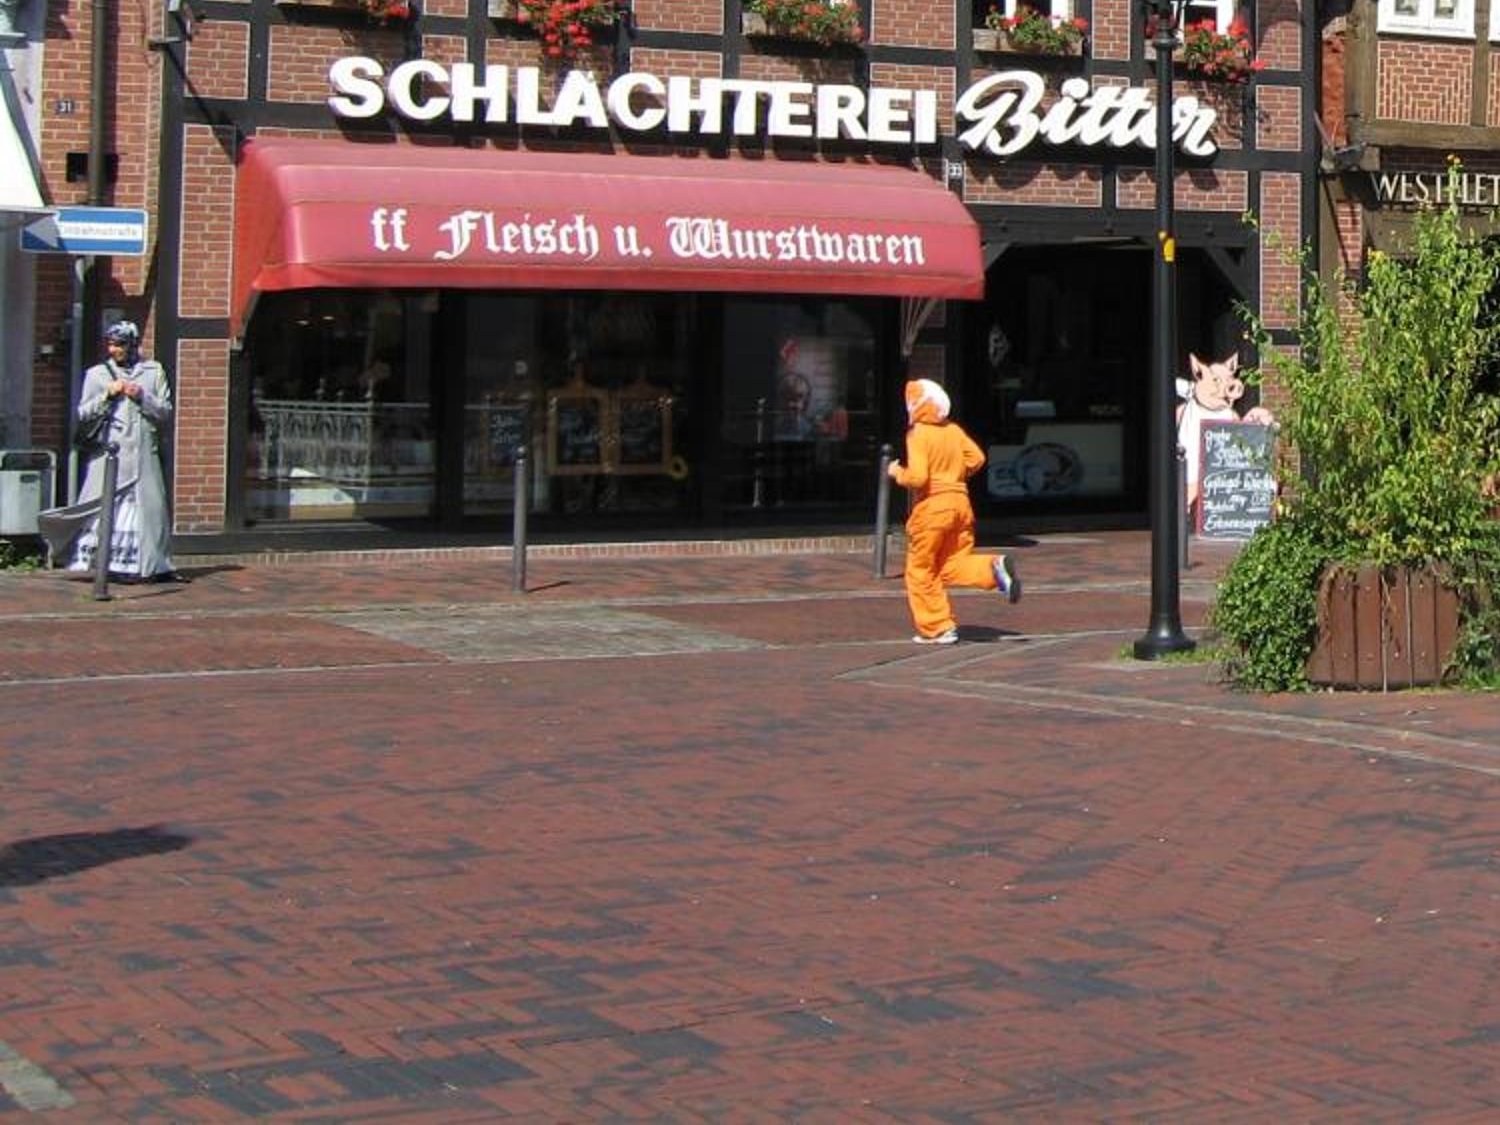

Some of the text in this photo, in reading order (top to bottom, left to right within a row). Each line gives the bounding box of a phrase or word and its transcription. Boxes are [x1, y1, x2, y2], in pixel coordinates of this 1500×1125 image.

[60, 101, 72, 114] 31
[328, 56, 937, 143] SCHLACHTEREI
[433, 209, 600, 262] Fleisch
[613, 224, 653, 258] u.
[665, 215, 926, 266] Wurstwaren
